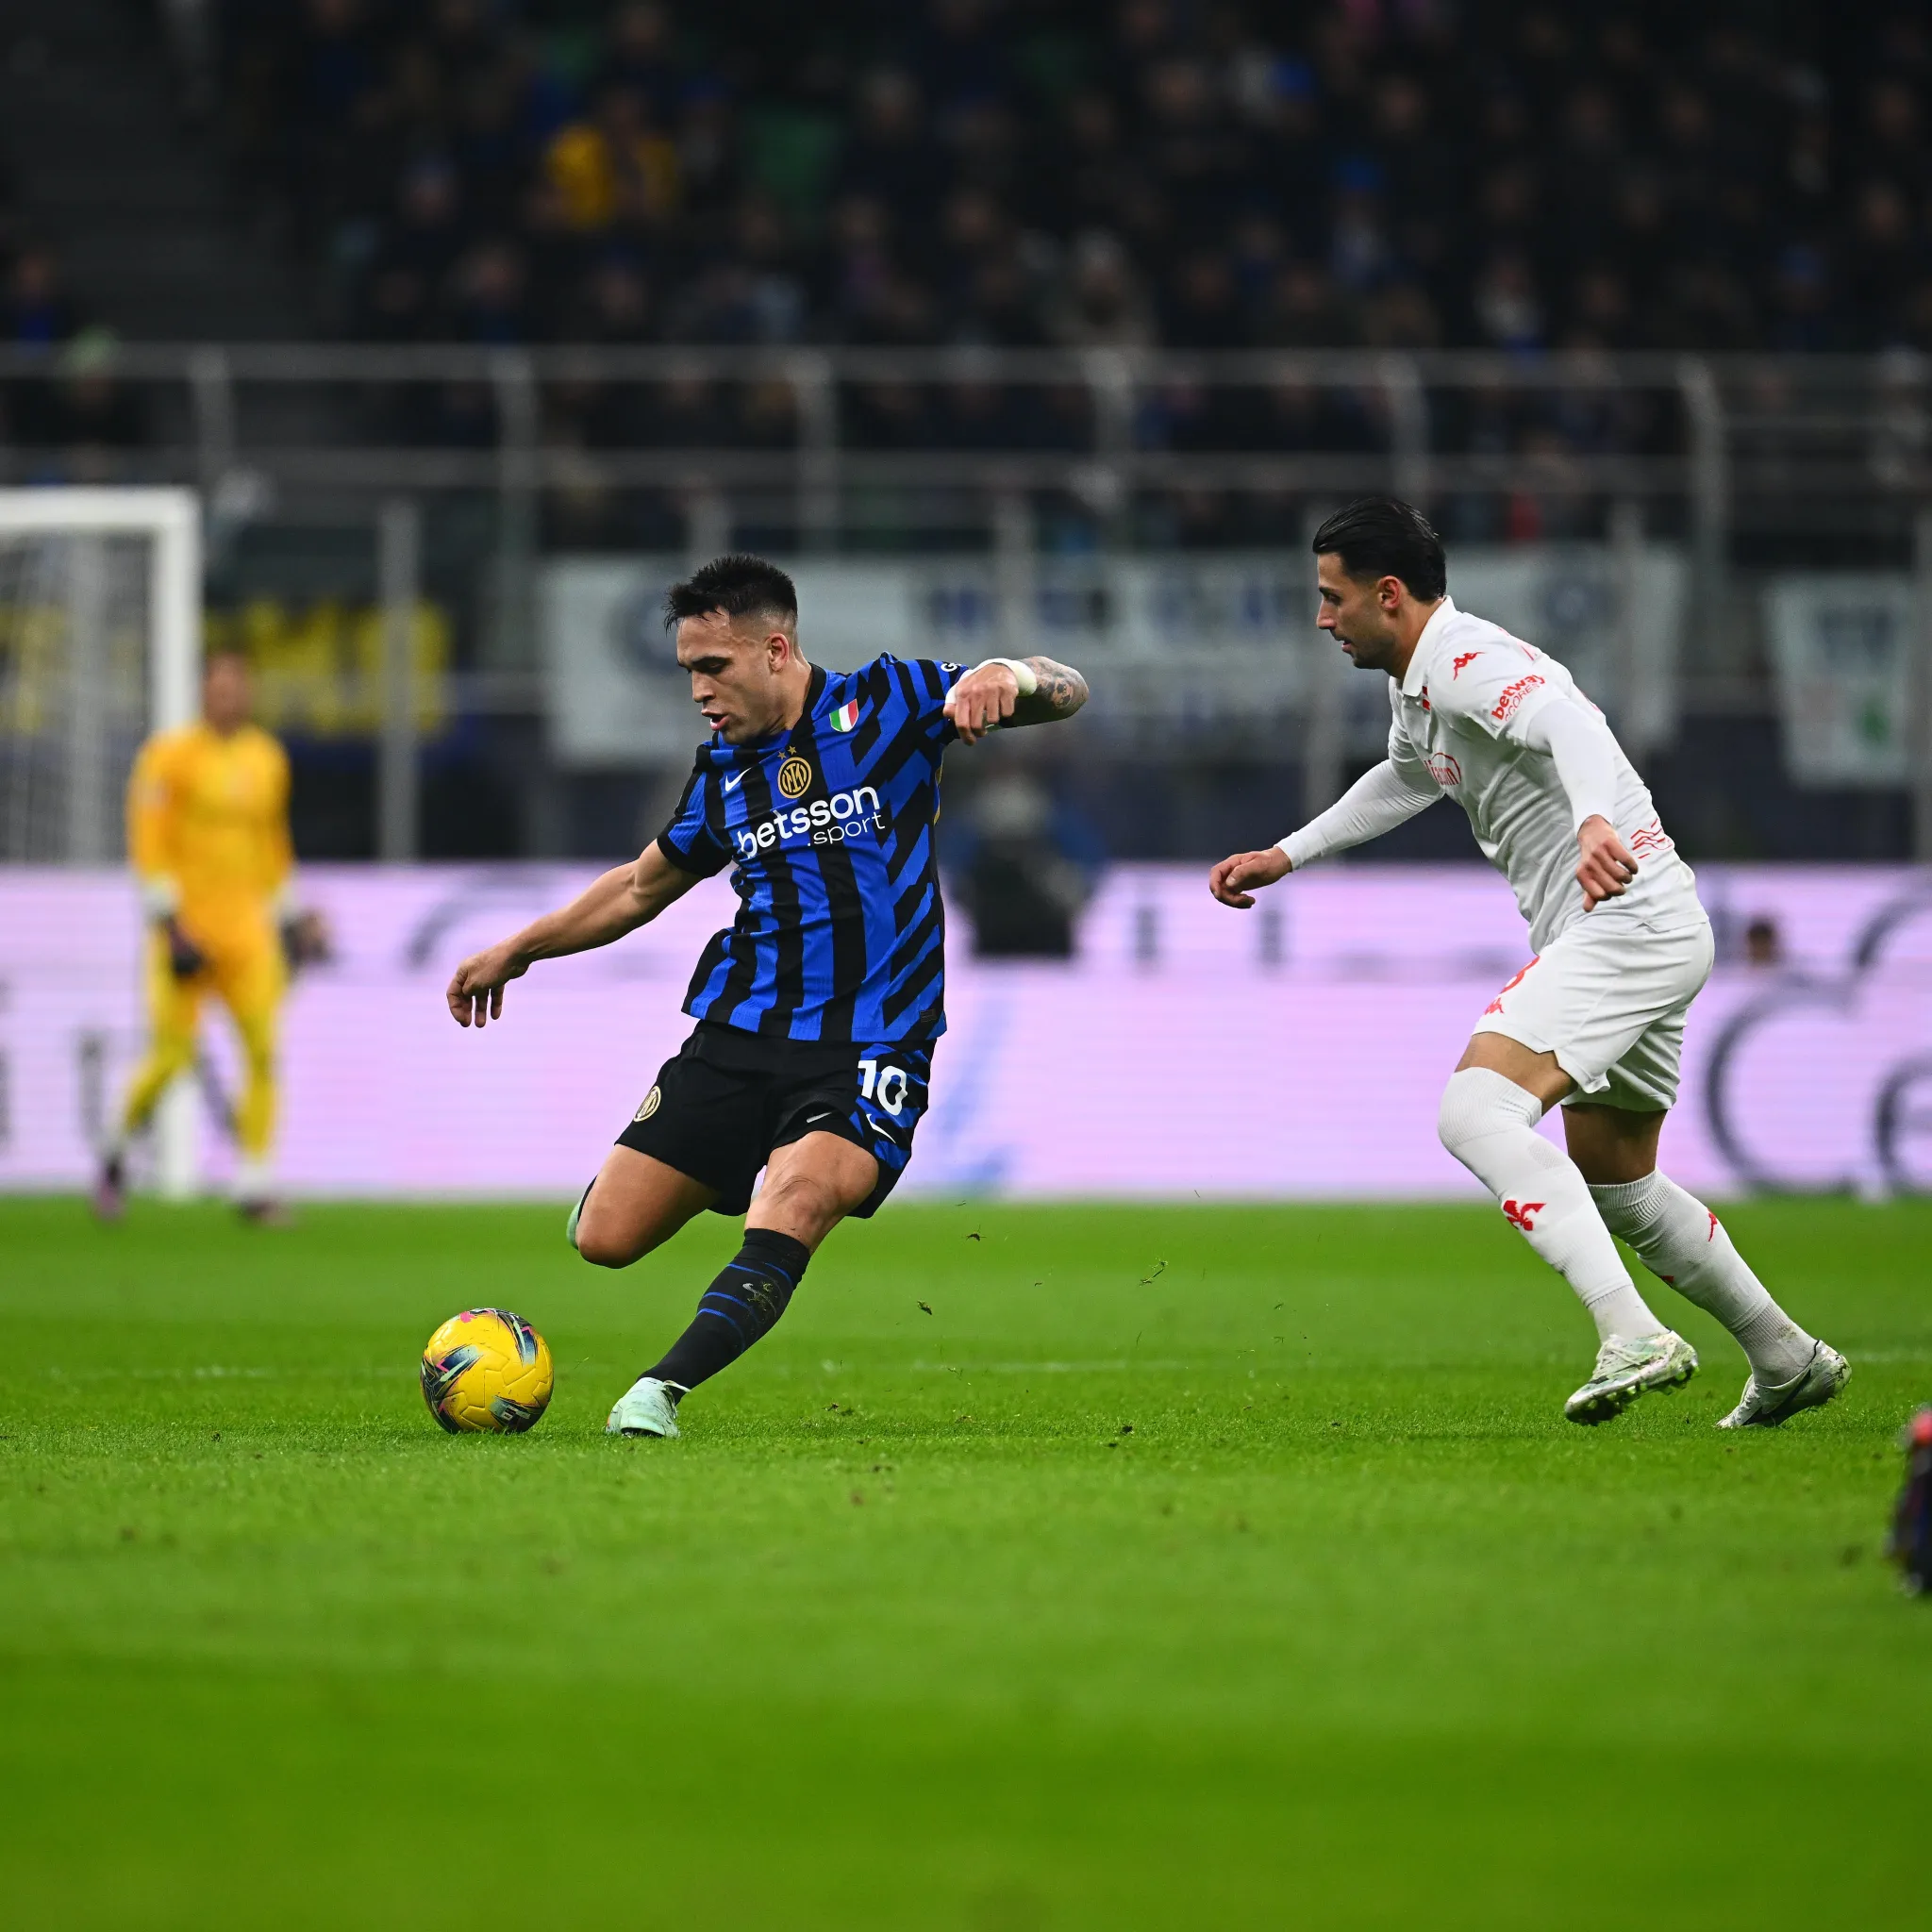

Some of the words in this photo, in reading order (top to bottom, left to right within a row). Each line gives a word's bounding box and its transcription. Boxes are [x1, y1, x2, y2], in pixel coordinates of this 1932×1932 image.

[1491, 674, 1545, 720] betway
[737, 786, 881, 859] betsson
[857, 1059, 908, 1116] 10
